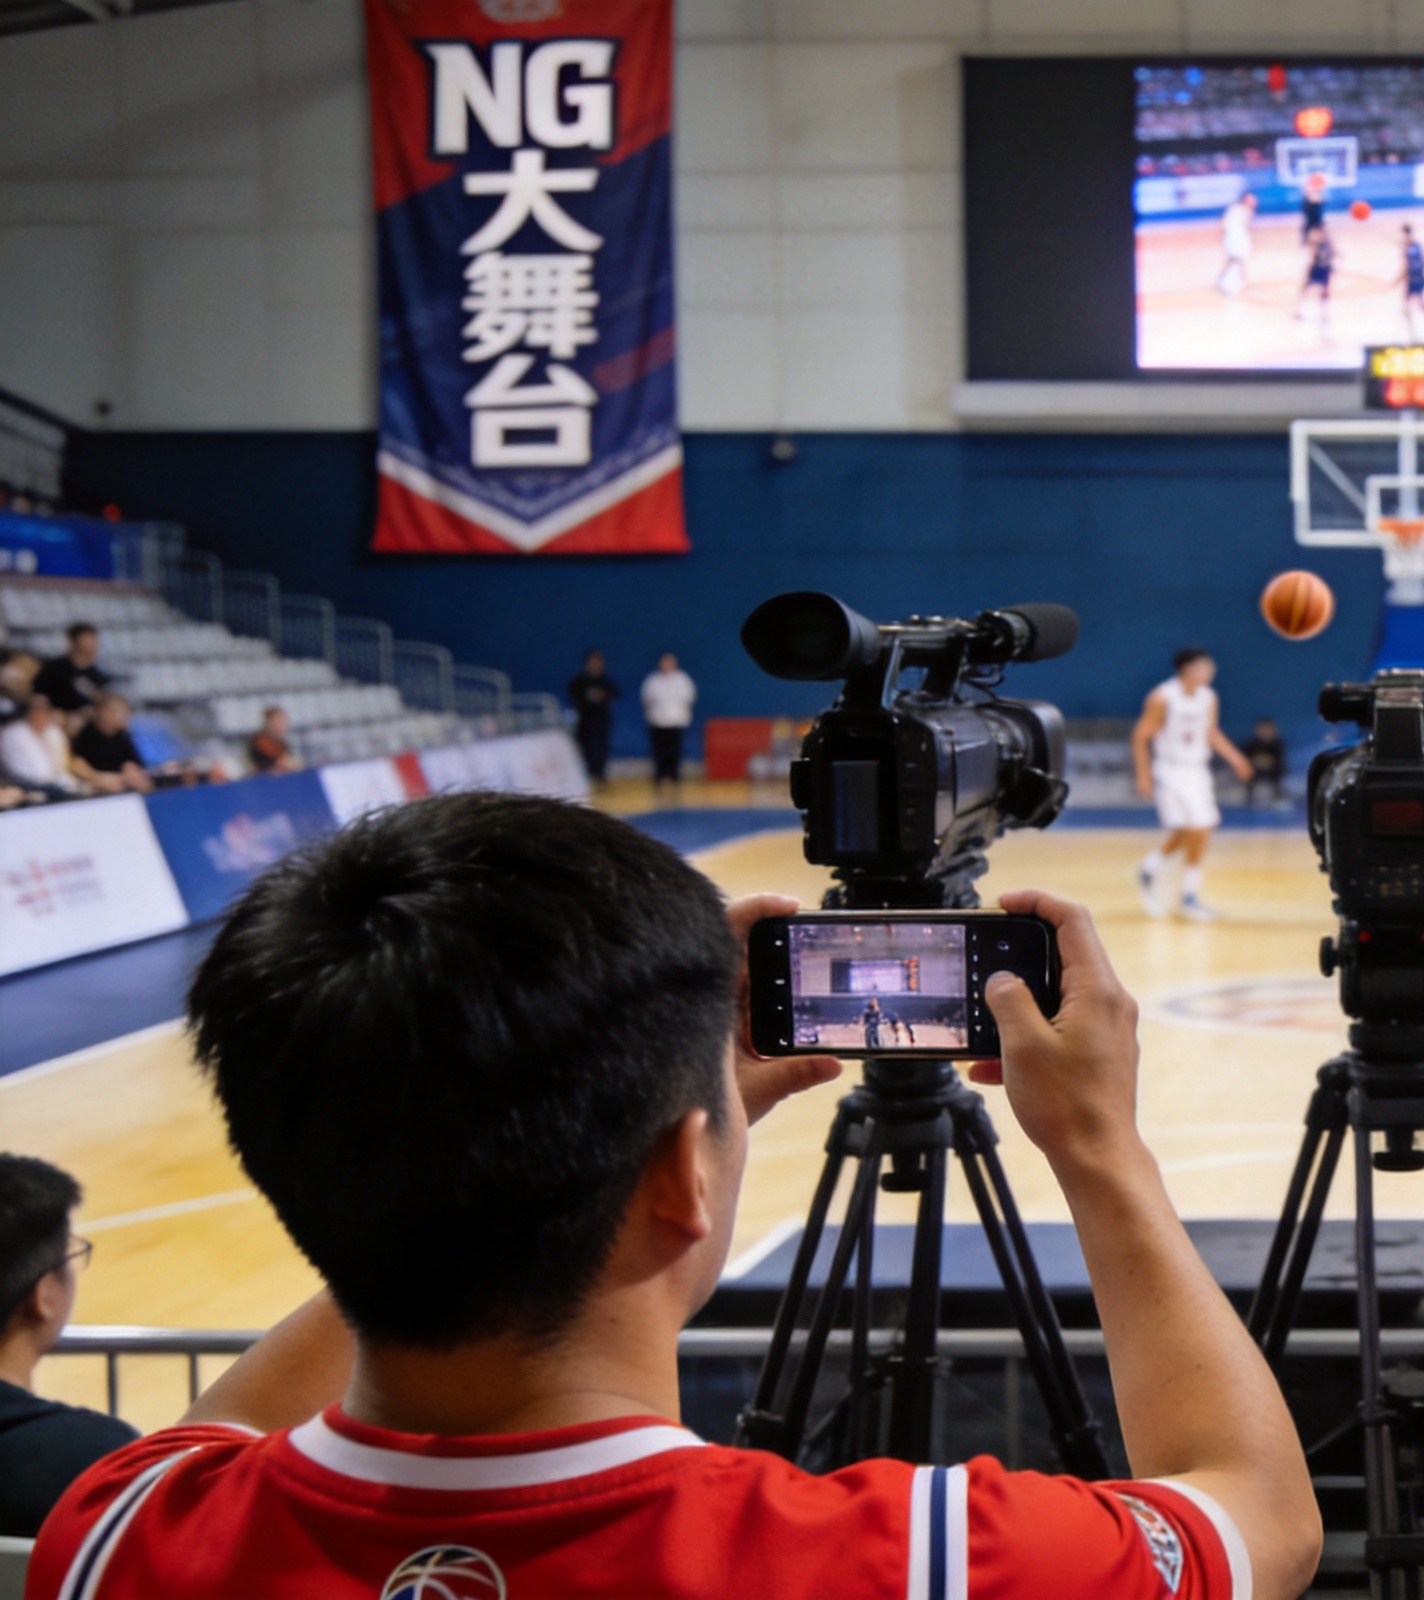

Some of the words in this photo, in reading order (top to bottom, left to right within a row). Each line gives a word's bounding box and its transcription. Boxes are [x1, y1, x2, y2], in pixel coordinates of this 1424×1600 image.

[426, 40, 614, 154] NG
[460, 149, 603, 468] 大舞台
